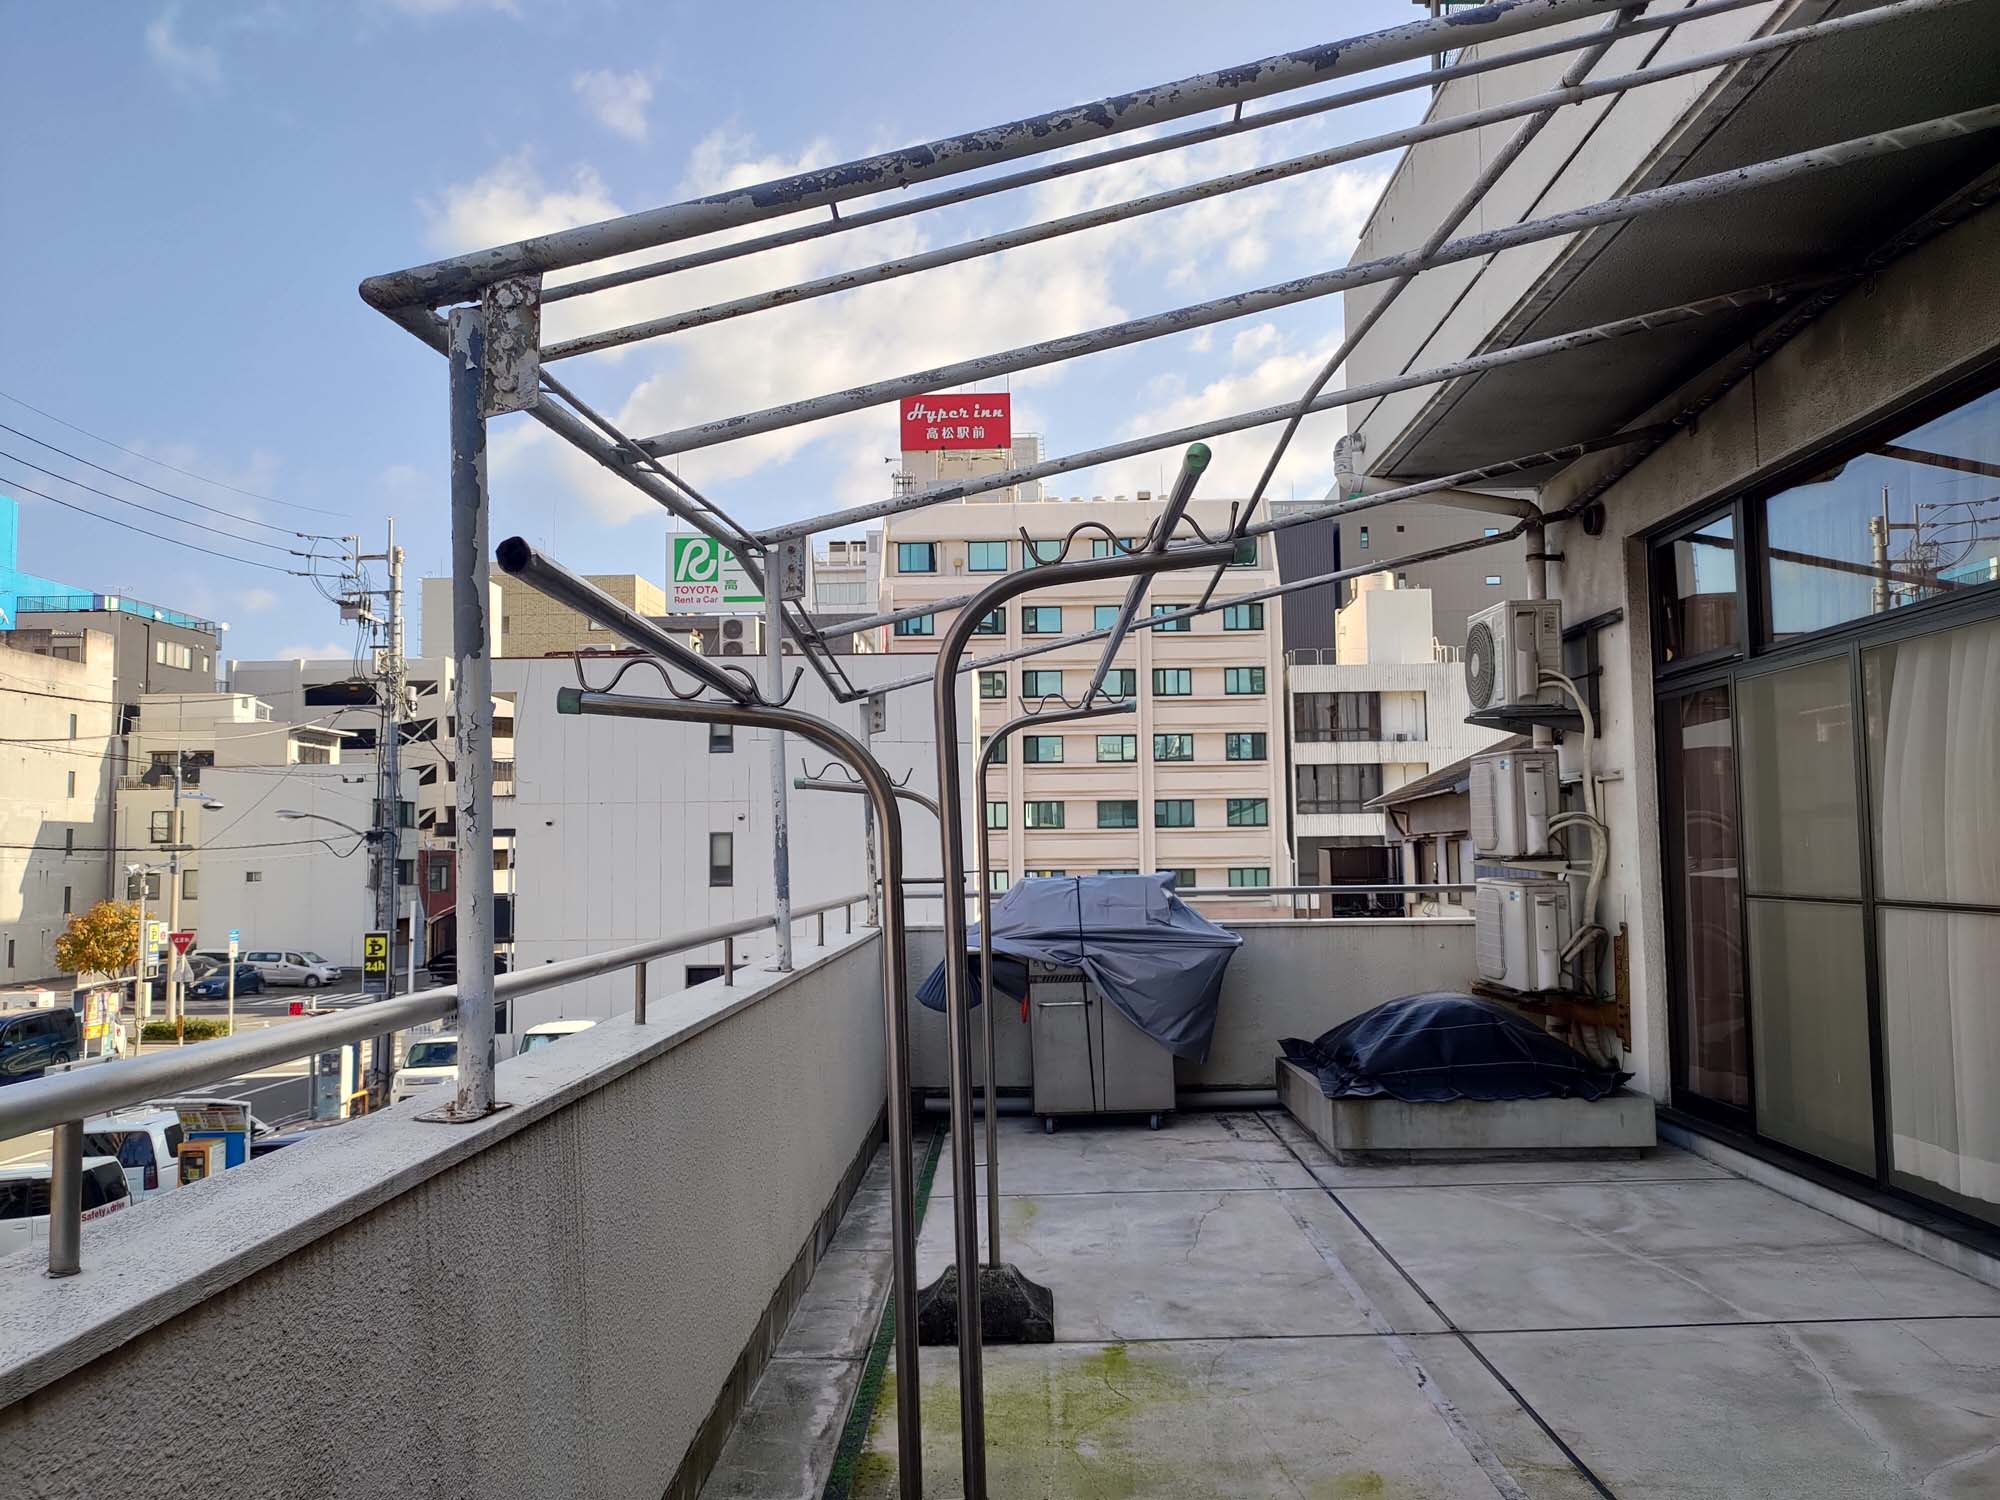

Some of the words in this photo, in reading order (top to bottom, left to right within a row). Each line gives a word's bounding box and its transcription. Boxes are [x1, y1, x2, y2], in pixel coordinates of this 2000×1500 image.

[907, 403, 969, 422] Hyper
[974, 404, 1004, 418] inn
[926, 426, 985, 440] 高松駅前
[674, 585, 719, 594] TOYOTA
[674, 596, 694, 604] Rent
[703, 595, 718, 604] Car
[368, 943, 383, 956] P
[365, 960, 385, 972] 24h
[81, 1208, 105, 1222] Safety
